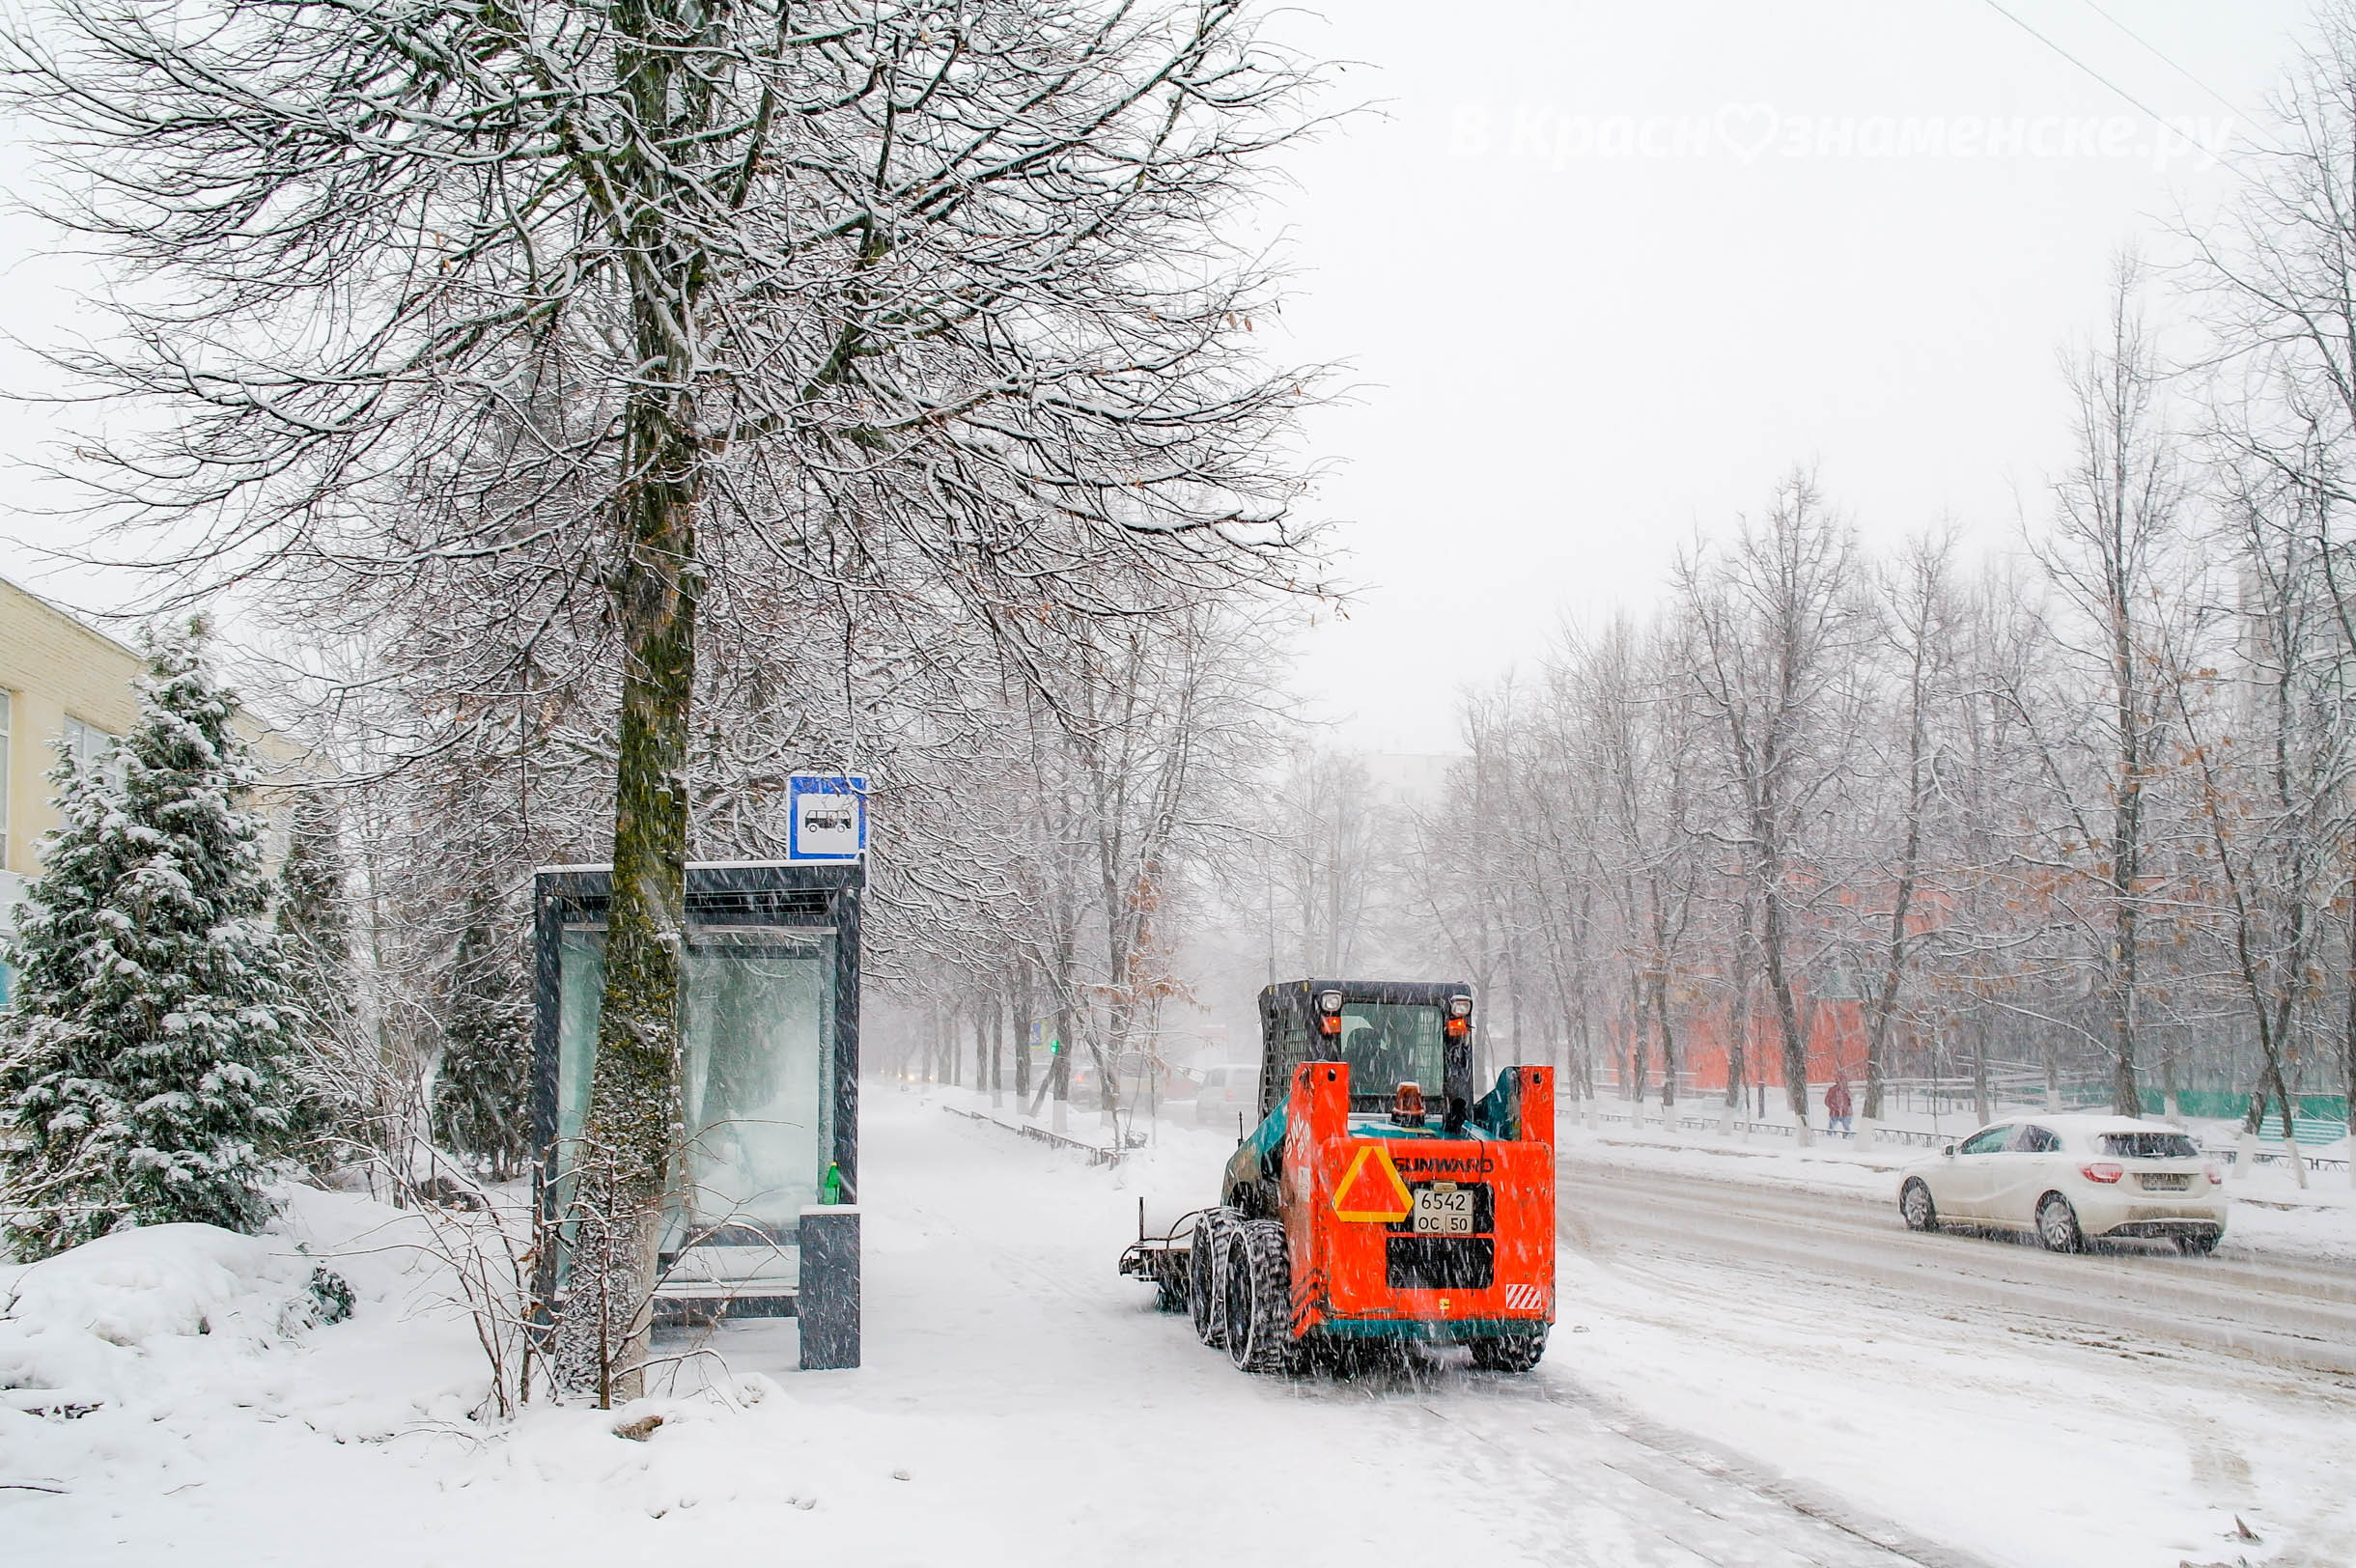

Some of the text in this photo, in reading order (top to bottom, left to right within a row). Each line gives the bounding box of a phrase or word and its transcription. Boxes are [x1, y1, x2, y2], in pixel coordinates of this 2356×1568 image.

[1392, 1158, 1495, 1173] SUNWARD
[1421, 1192, 1466, 1212] 6542
[1418, 1217, 1468, 1231] ОС 50
